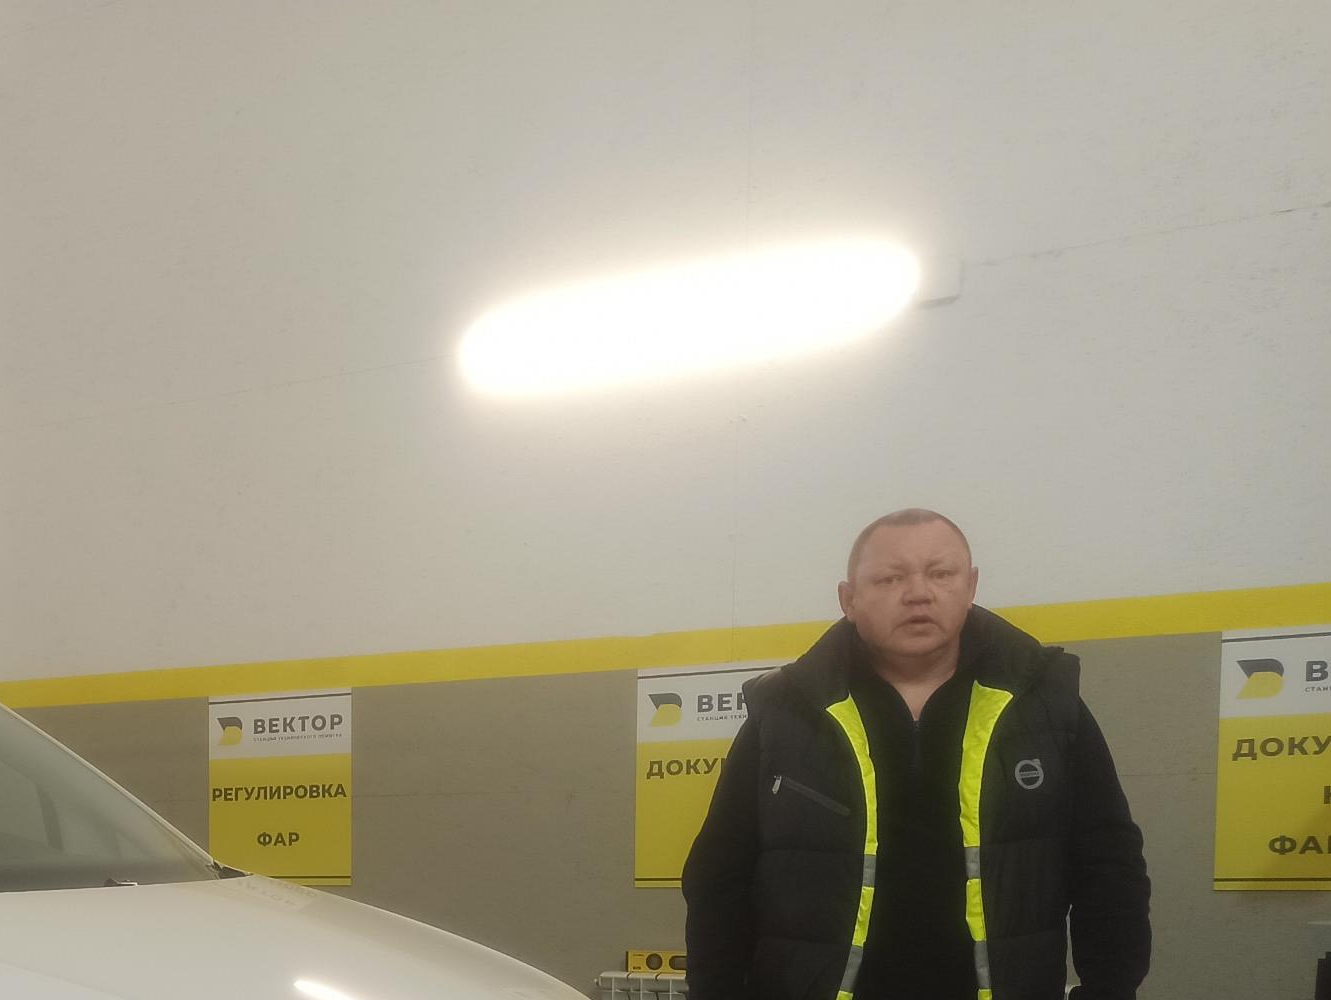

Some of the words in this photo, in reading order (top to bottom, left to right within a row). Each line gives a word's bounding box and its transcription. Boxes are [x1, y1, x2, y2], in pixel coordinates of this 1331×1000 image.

[253, 714, 344, 734] ВЕКТОР
[646, 757, 725, 780] ДОКУ
[212, 783, 347, 802] РЕГУЛИРОВКА
[257, 832, 300, 847] ФАР
[1268, 835, 1331, 856] ФА
